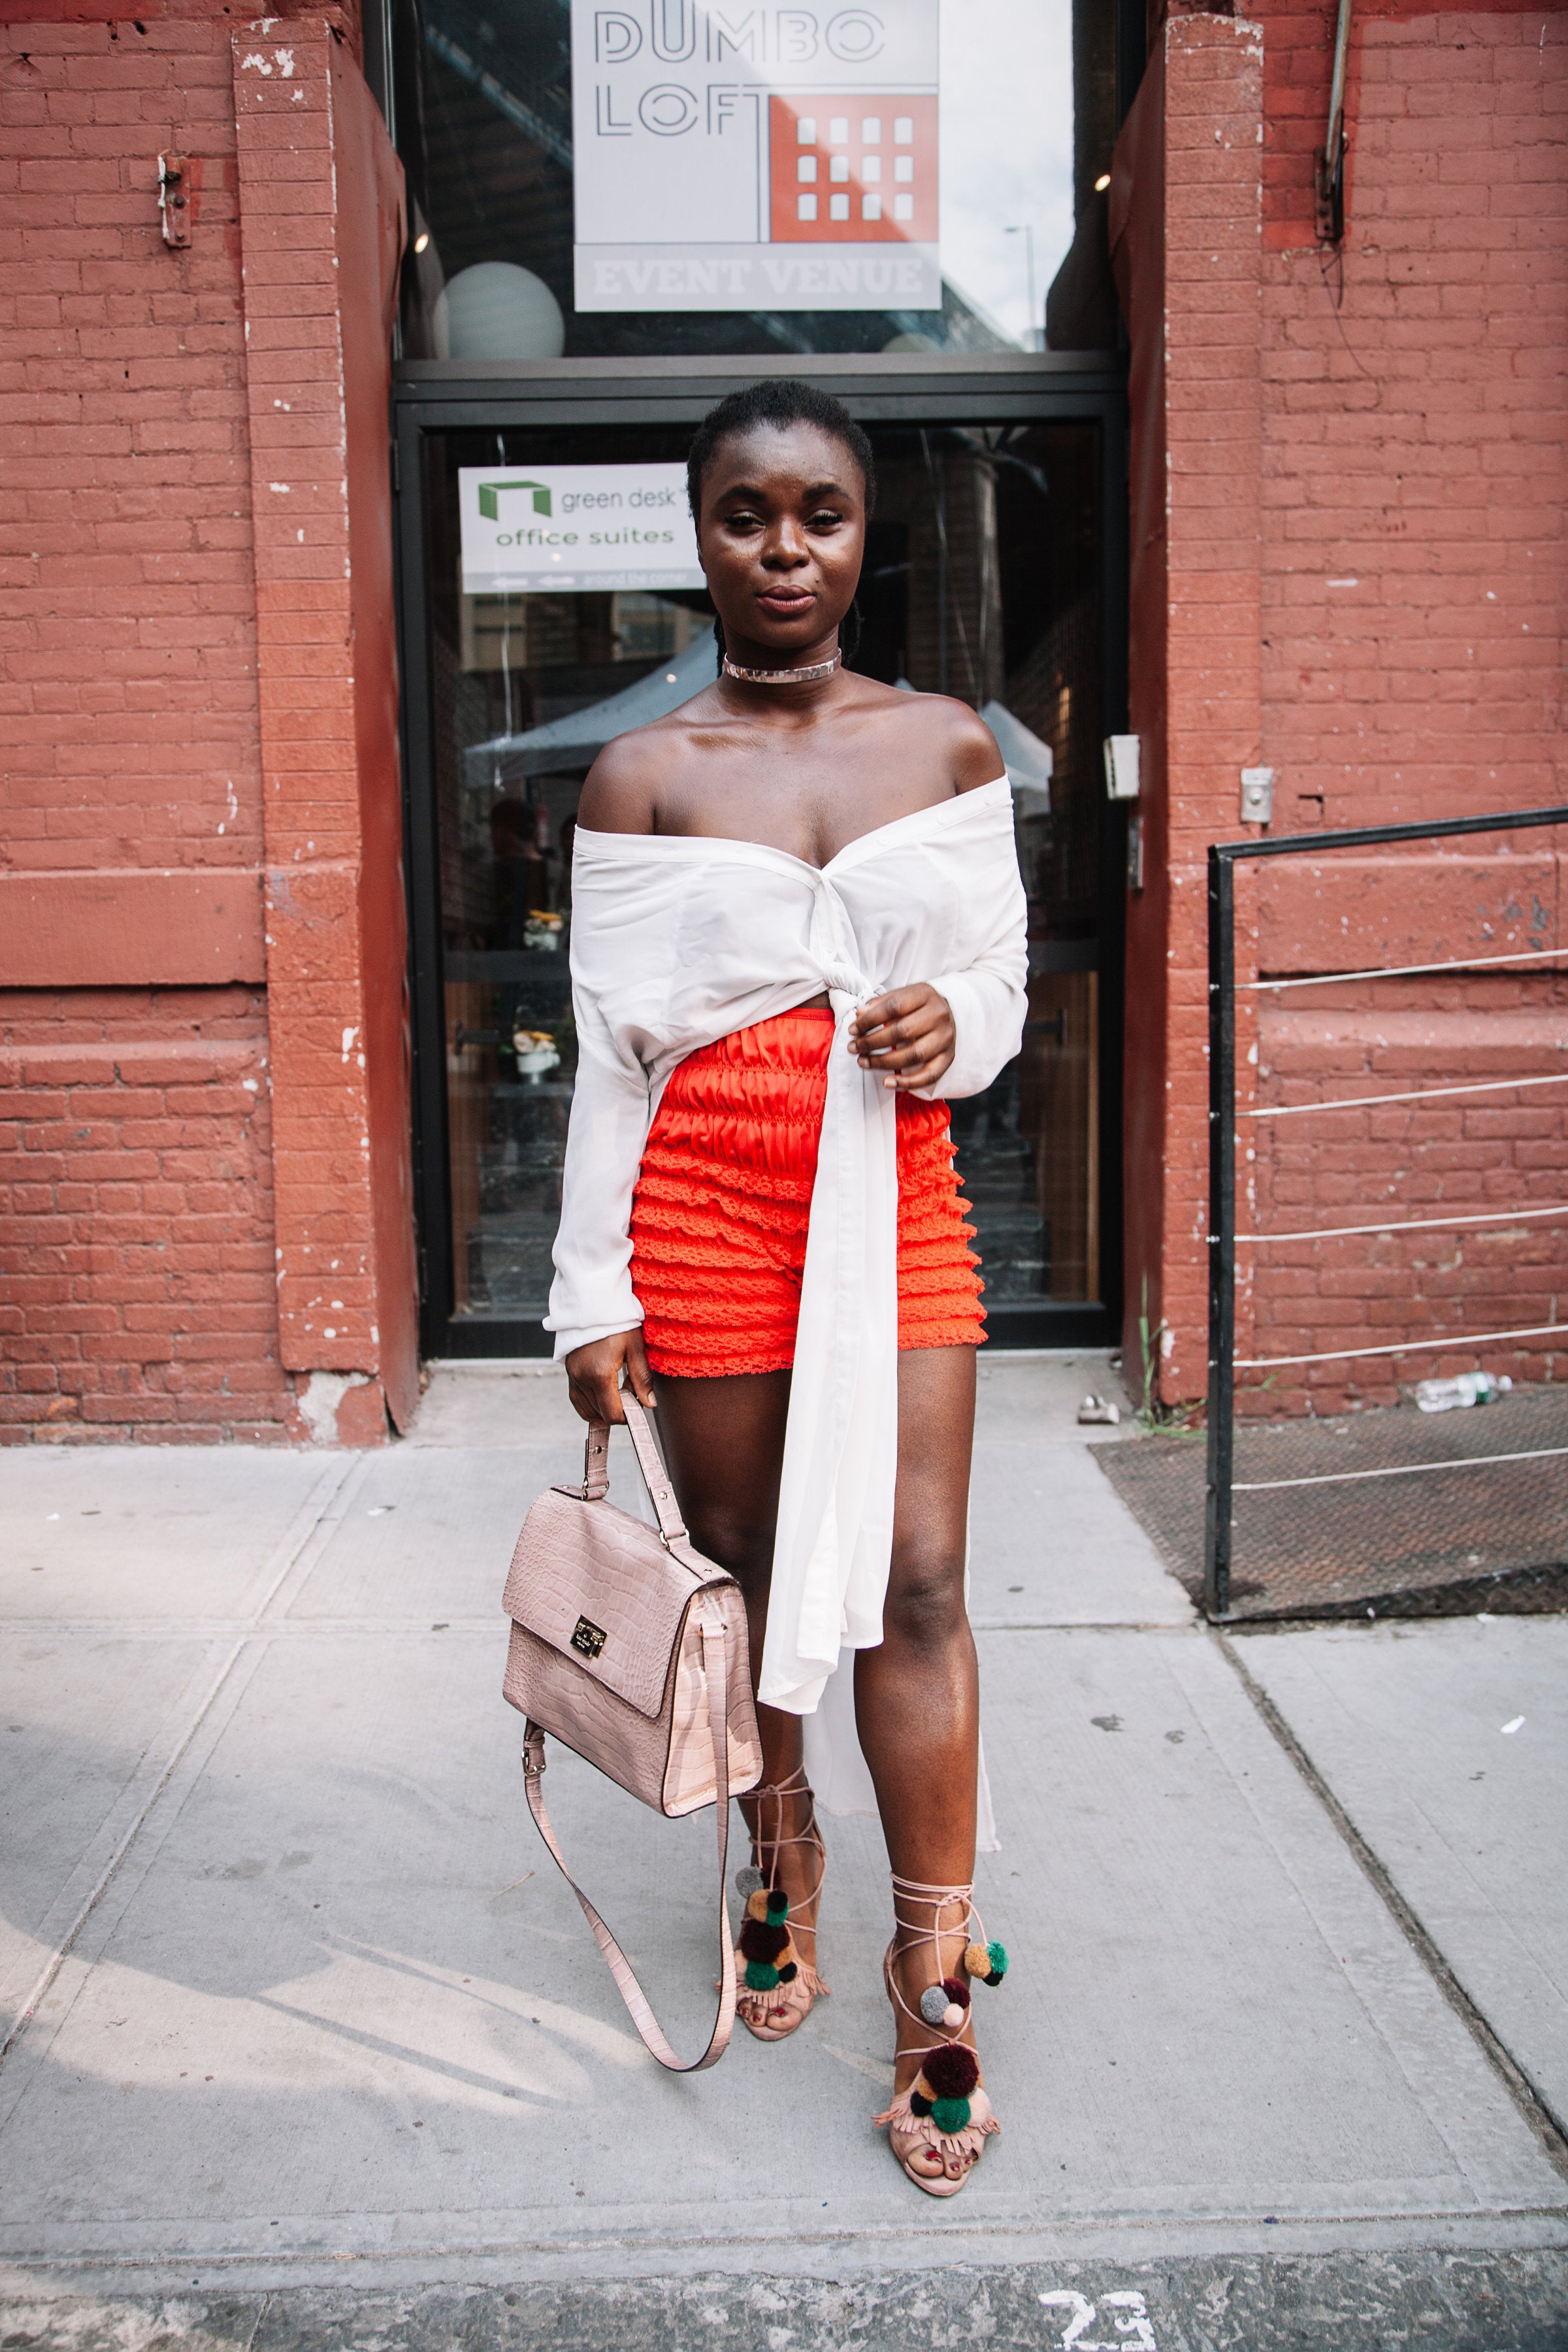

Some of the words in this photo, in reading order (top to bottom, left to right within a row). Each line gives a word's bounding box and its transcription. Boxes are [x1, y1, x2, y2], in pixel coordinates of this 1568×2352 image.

[595, 0, 886, 63] DUMBO
[593, 259, 751, 295] EVENT
[760, 258, 923, 294] VENUE
[561, 492, 623, 514] green
[628, 487, 676, 508] desk
[496, 529, 579, 547] office
[589, 527, 674, 545] suites
[1037, 2289, 1156, 2352] 23
